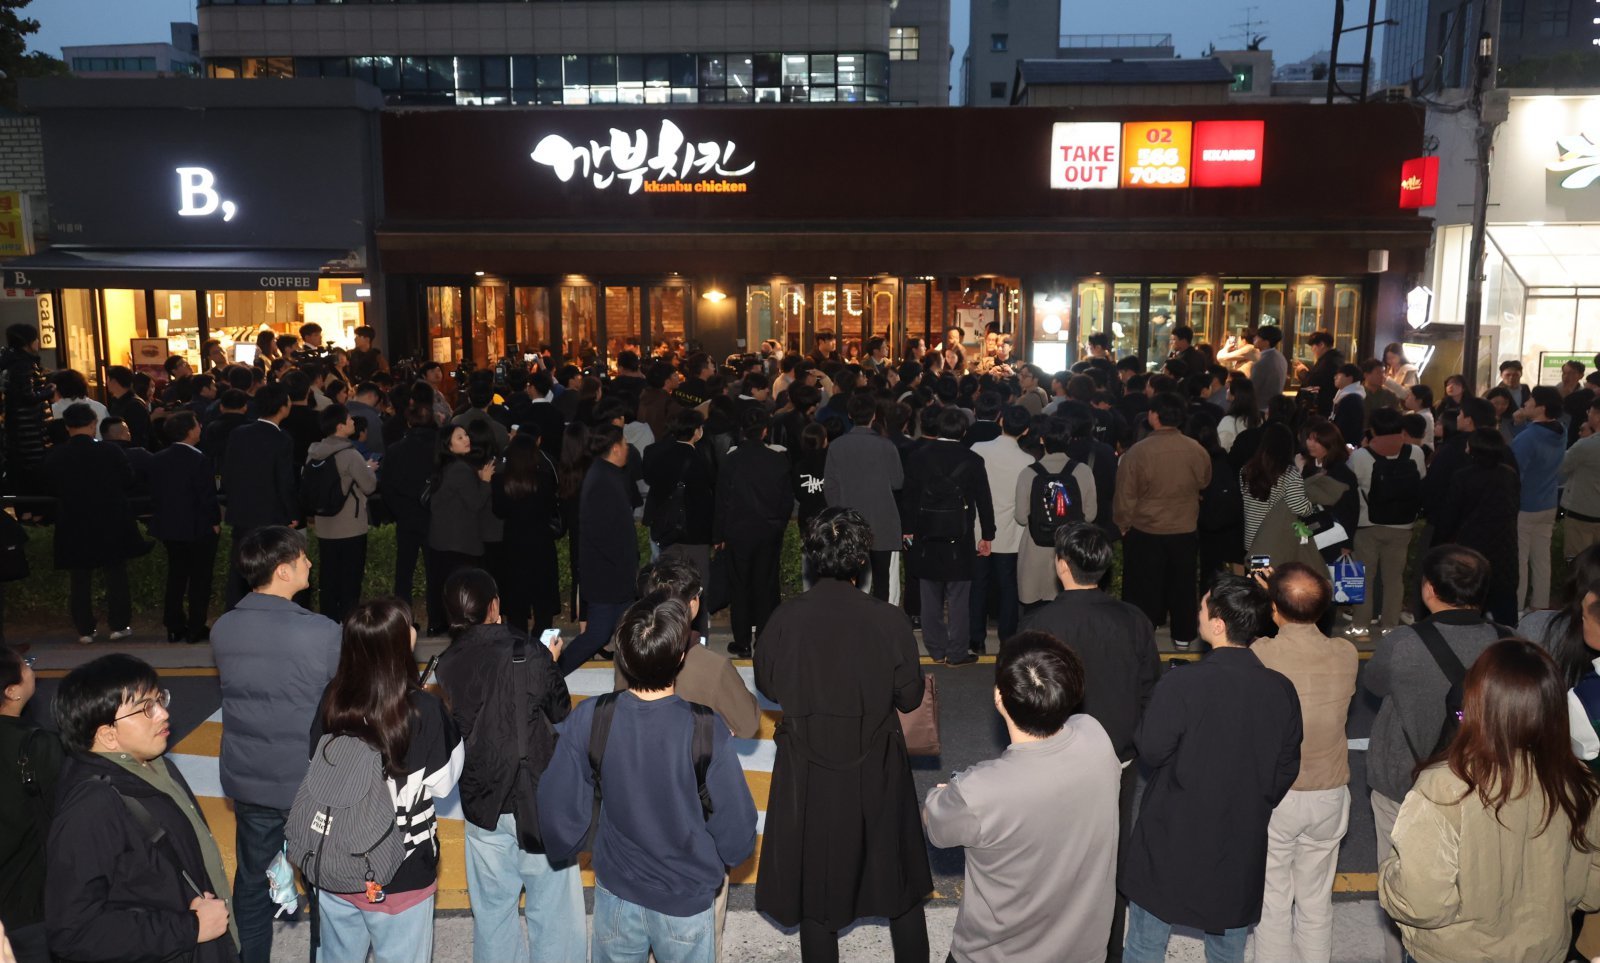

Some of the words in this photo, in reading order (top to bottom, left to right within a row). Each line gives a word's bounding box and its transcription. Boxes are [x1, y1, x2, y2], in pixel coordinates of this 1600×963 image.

[1146, 128, 1172, 143] 02
[530, 118, 756, 195] 깐부치킨
[1060, 145, 1115, 162] TAKE
[1064, 166, 1108, 183] OUT
[175, 166, 237, 222] B,
[643, 180, 693, 192] kkanbu
[694, 180, 747, 192] chicken
[260, 276, 310, 288] COFFEE
[39, 297, 55, 345] cafe
